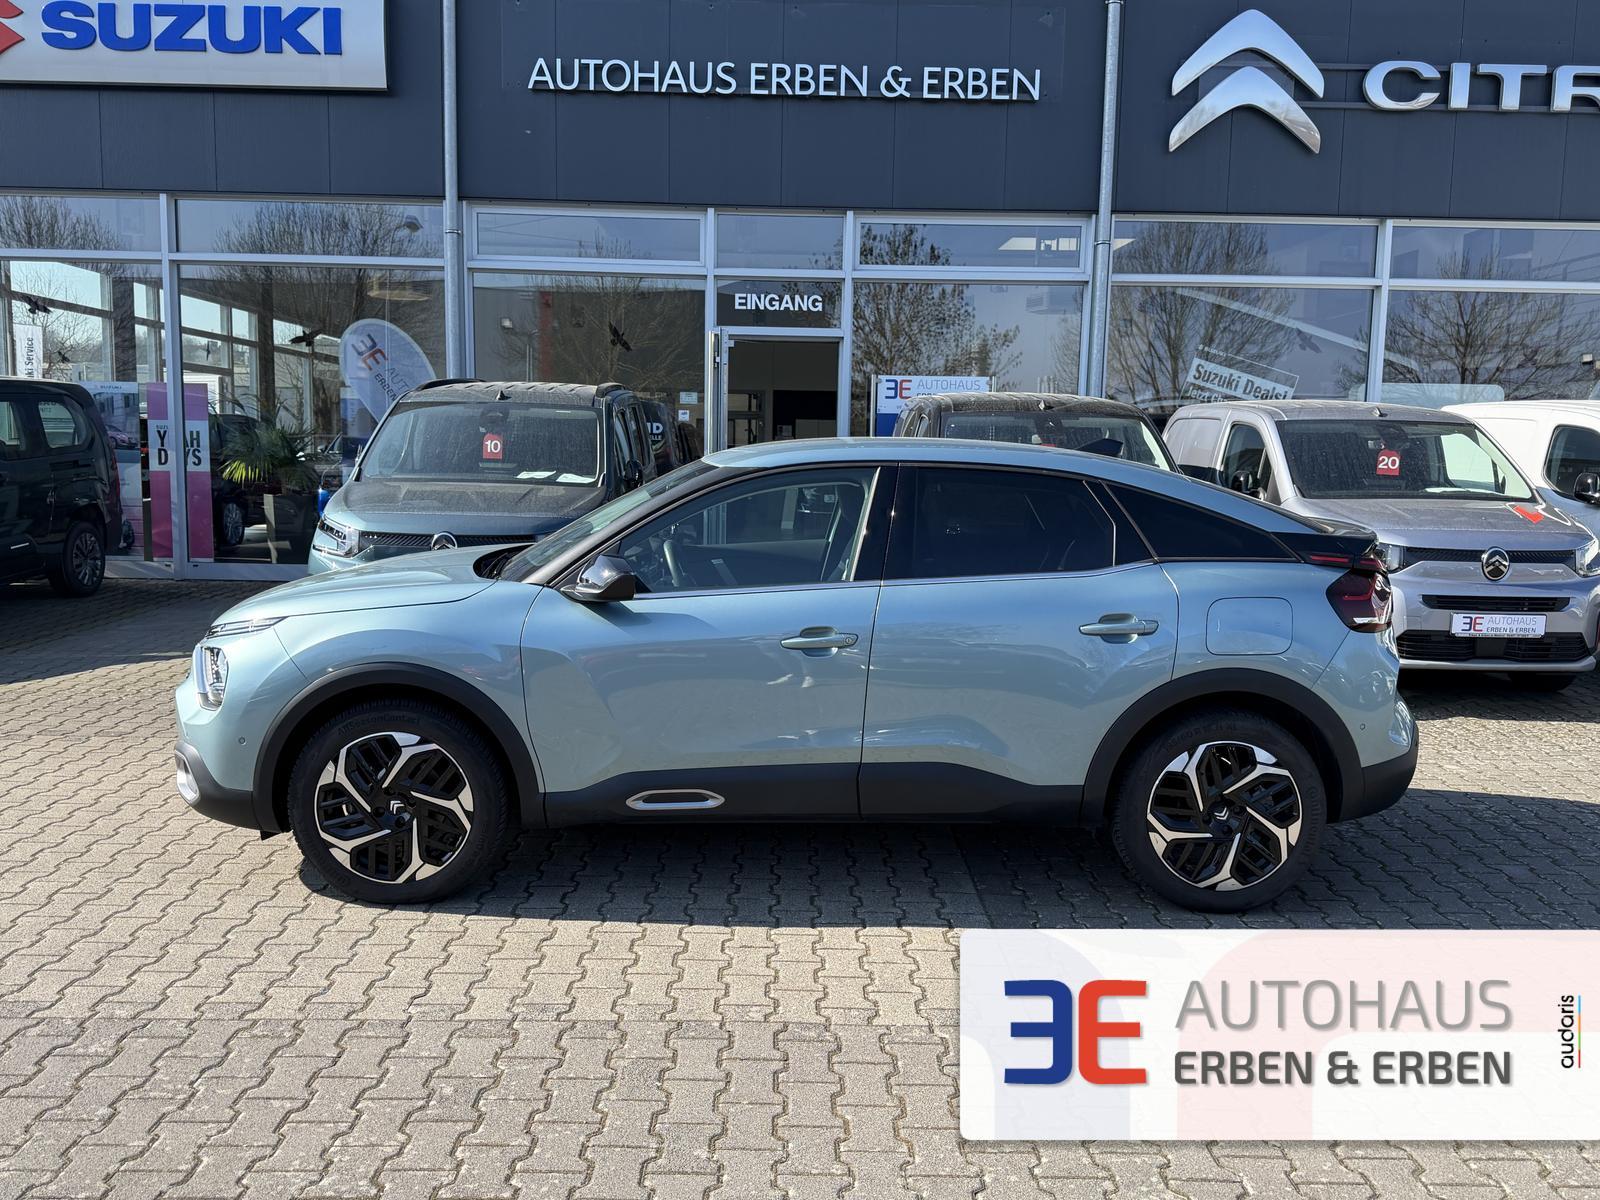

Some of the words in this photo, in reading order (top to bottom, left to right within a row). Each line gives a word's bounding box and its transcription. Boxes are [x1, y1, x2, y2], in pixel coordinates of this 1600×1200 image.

[41, 0, 343, 56] SUZUKI
[528, 57, 736, 95] AUTOHAUS
[749, 62, 869, 98] ERBEN
[879, 65, 912, 99] &
[922, 66, 1042, 102] ERBEN
[734, 293, 823, 312] EINGANG
[24, 337, 35, 366] Service
[917, 379, 981, 390] AUTOHAUS
[1193, 363, 1242, 392] Suzuki
[484, 440, 502, 453] 10
[1378, 455, 1400, 470] 20
[1487, 616, 1537, 625] AUTOHAUS
